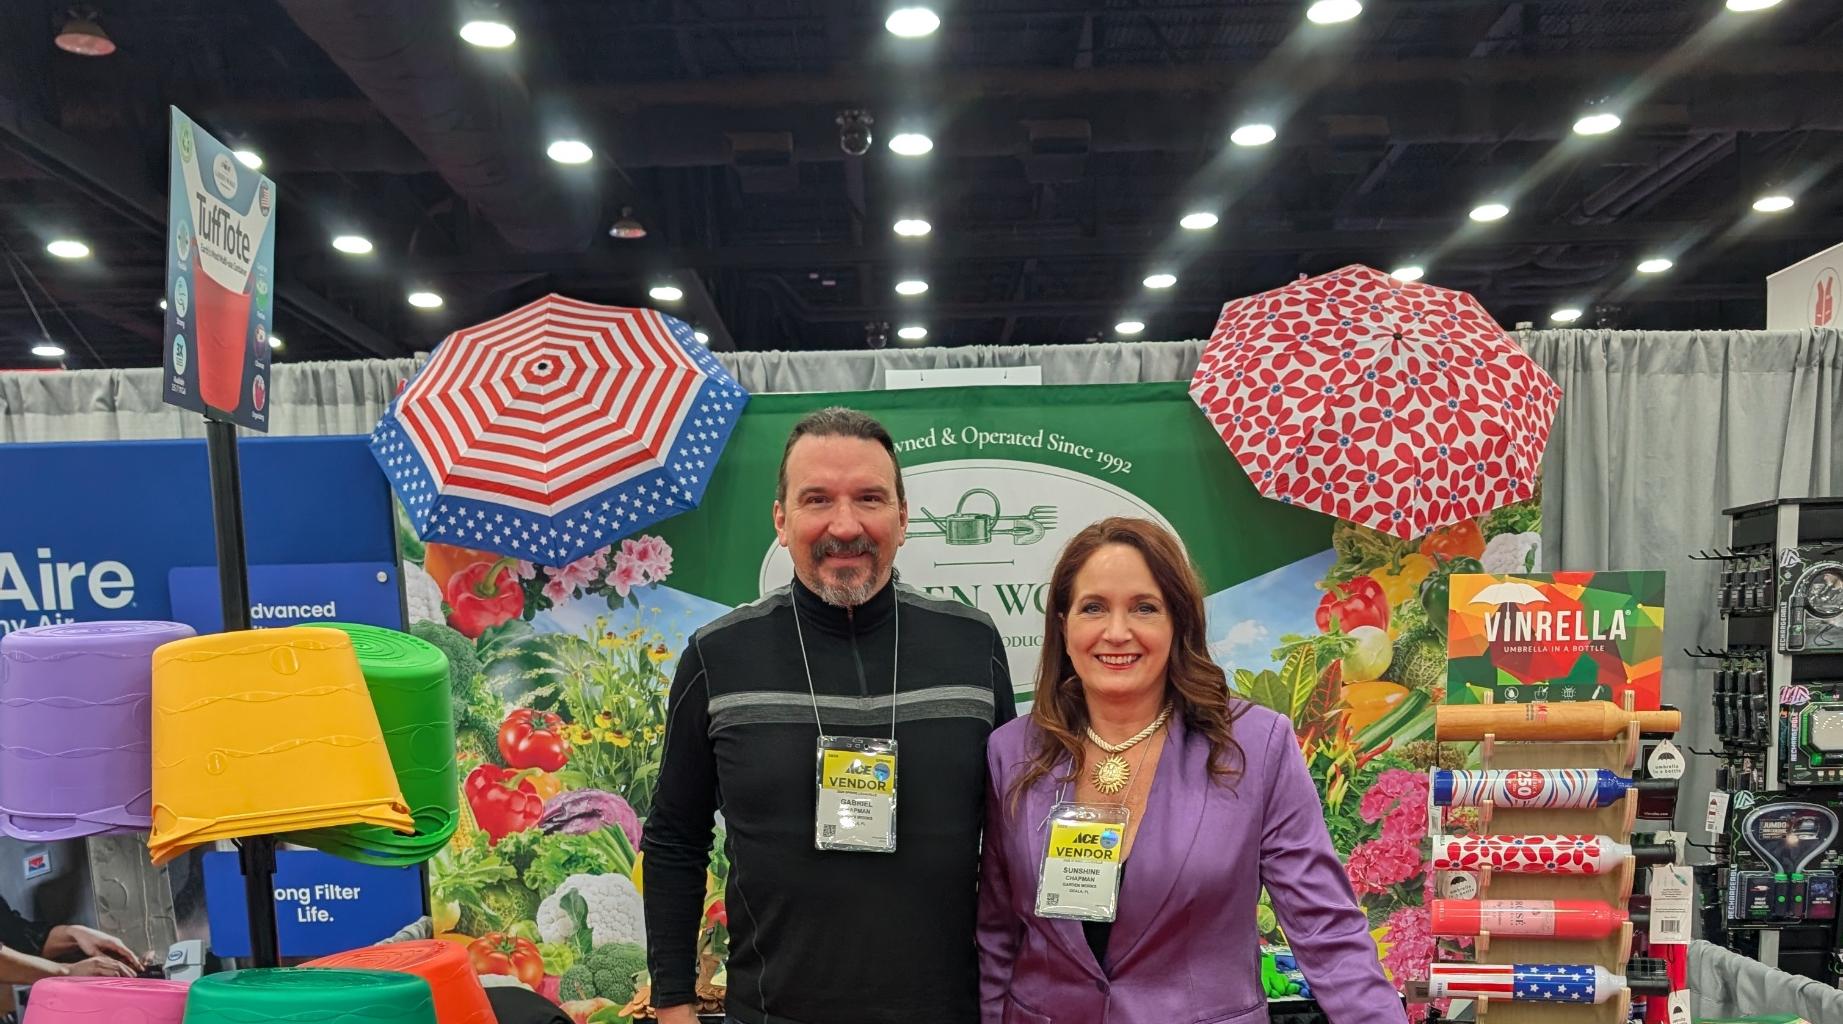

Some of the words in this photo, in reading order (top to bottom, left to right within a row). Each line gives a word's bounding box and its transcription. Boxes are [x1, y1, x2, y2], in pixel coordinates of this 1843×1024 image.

[197, 191, 250, 264] TuffTote
[893, 427, 937, 454] wned
[941, 427, 957, 446] &
[961, 426, 1043, 449] Operated
[1047, 433, 1093, 459] Since
[1097, 451, 1132, 475] 1992
[250, 601, 336, 619] dvanced
[1484, 609, 1627, 642] VINRELLA
[1503, 645, 1548, 653] UMBRELLA
[1551, 645, 1560, 653] IN
[1572, 644, 1605, 652] BOTTLE
[829, 776, 887, 792] VENDOR
[1517, 771, 1532, 797] 250
[1072, 832, 1101, 845] ACE
[1056, 846, 1113, 860] VENDOR
[1063, 866, 1101, 876] SUNSHINE
[274, 888, 310, 905] ong
[314, 883, 361, 900] Filter
[297, 906, 334, 923] Life.
